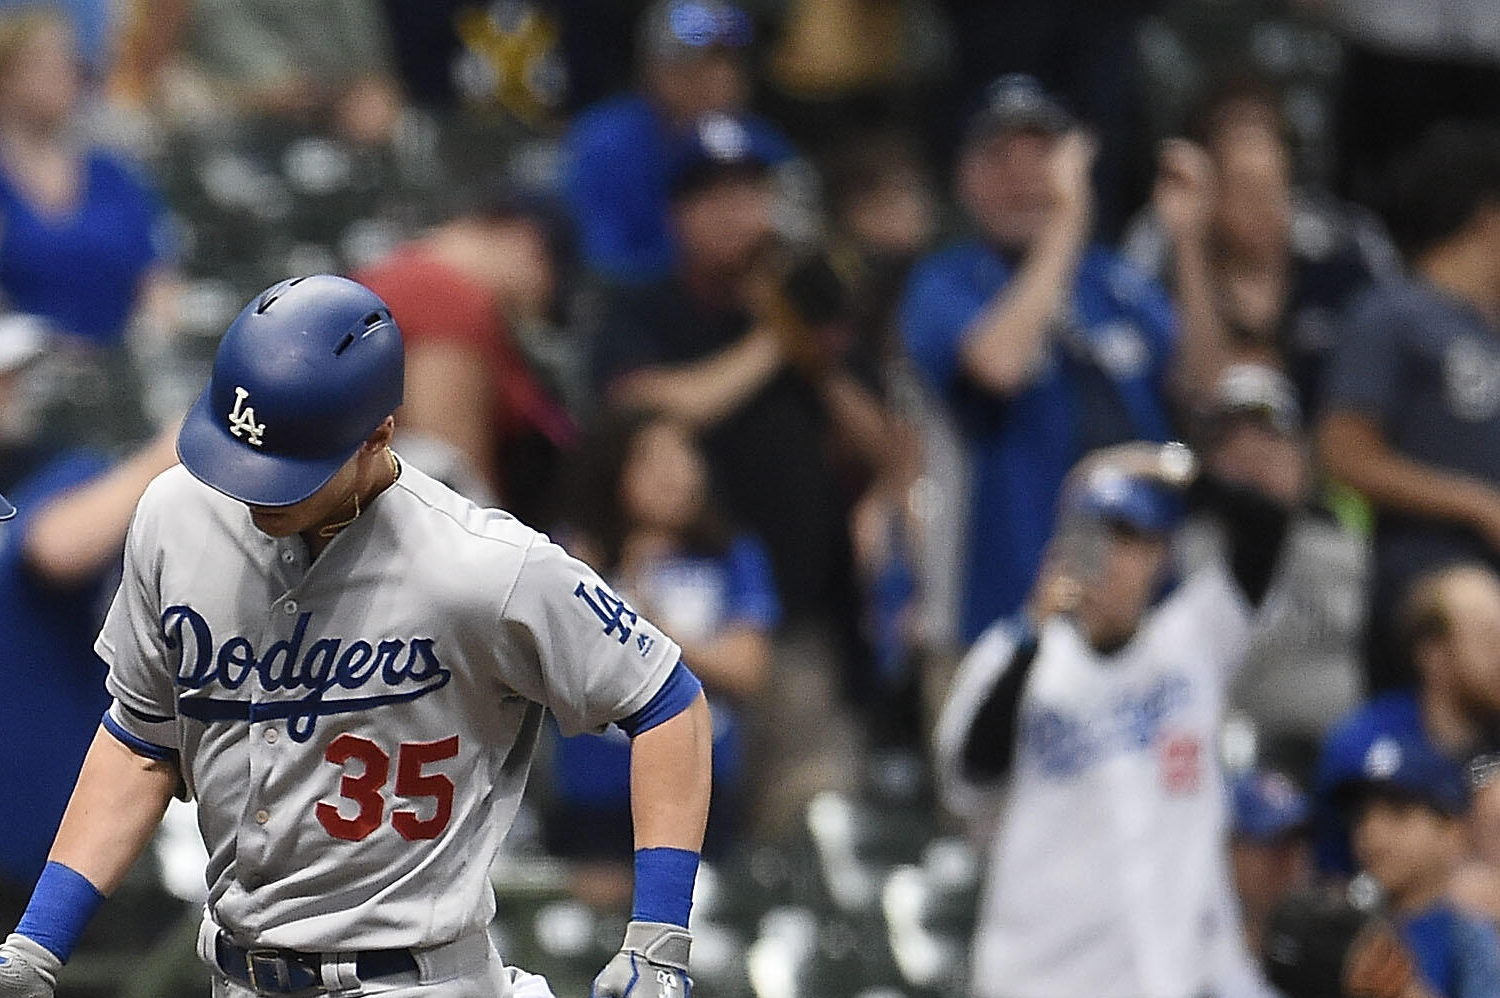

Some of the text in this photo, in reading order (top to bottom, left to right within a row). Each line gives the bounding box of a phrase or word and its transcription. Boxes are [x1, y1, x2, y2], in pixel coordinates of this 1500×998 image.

[229, 386, 266, 446] LA
[574, 581, 637, 645] LA
[161, 605, 451, 743] Dodgers
[316, 733, 459, 842] 35
